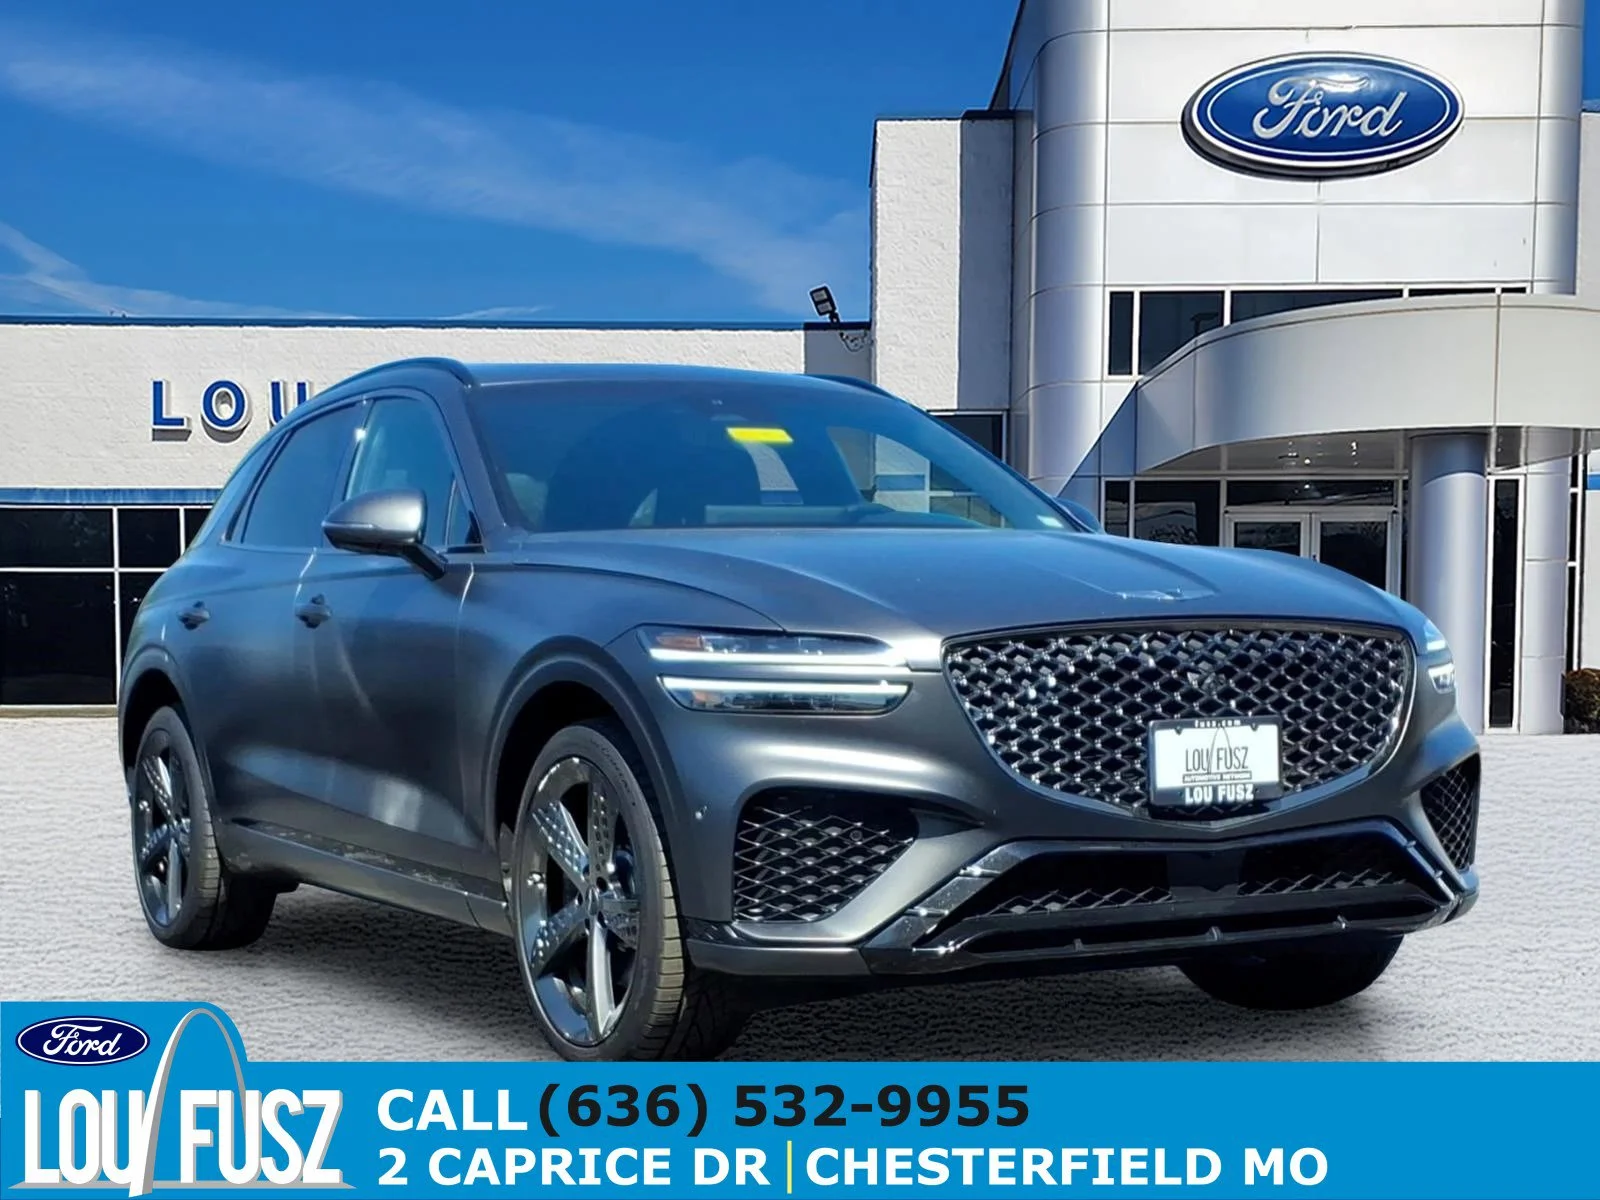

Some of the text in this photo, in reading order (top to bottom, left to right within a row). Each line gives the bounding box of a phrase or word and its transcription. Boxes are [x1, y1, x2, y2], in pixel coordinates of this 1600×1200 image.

[1253, 76, 1407, 138] Ford
[1185, 746, 1249, 773] LOU FUSZ
[1184, 784, 1254, 805] LOU FUSZ
